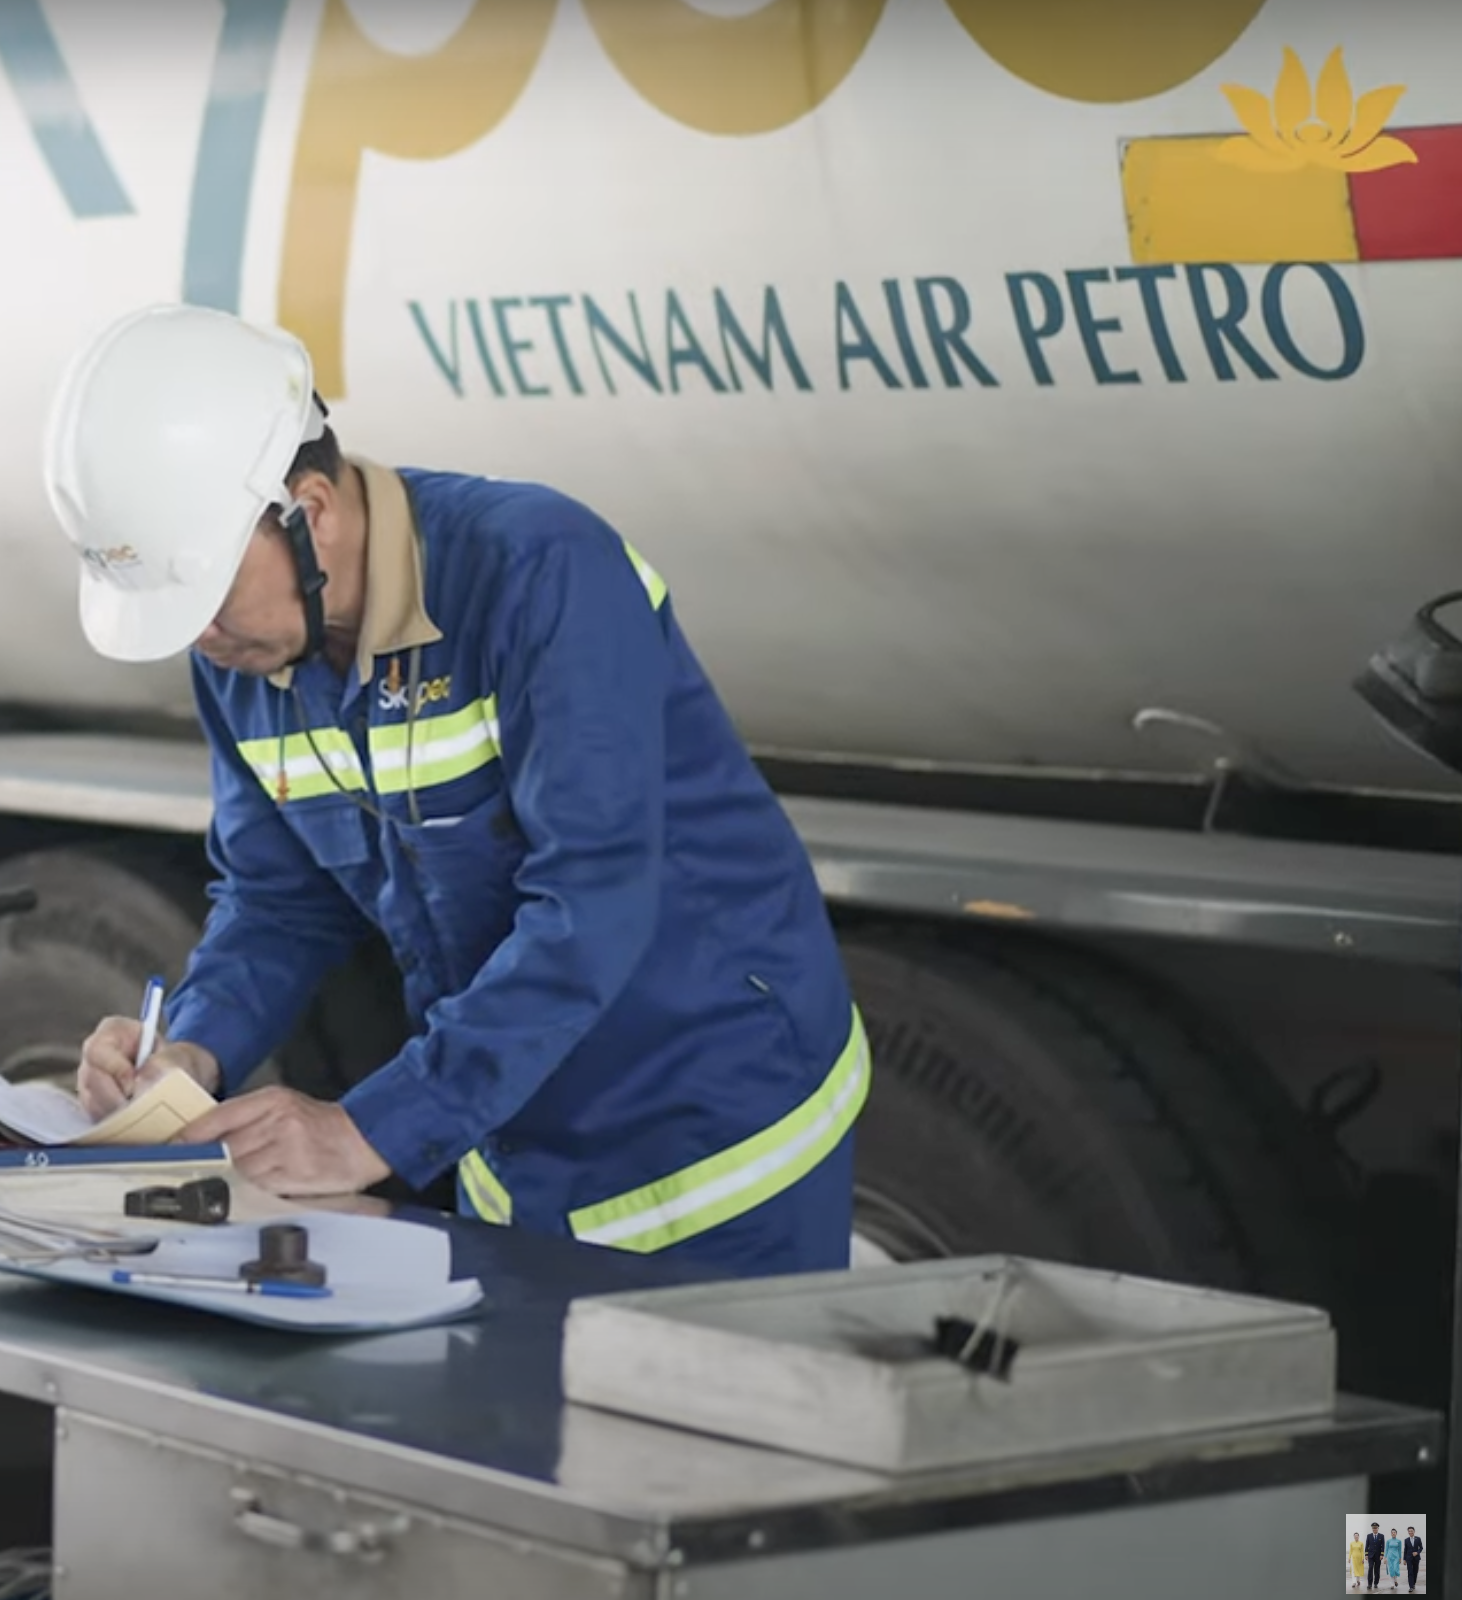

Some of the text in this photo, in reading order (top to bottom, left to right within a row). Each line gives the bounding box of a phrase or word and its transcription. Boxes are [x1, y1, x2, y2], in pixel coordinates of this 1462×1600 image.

[407, 261, 1367, 398] VIETNAM AIR PETRO
[378, 674, 451, 714] Skpec
